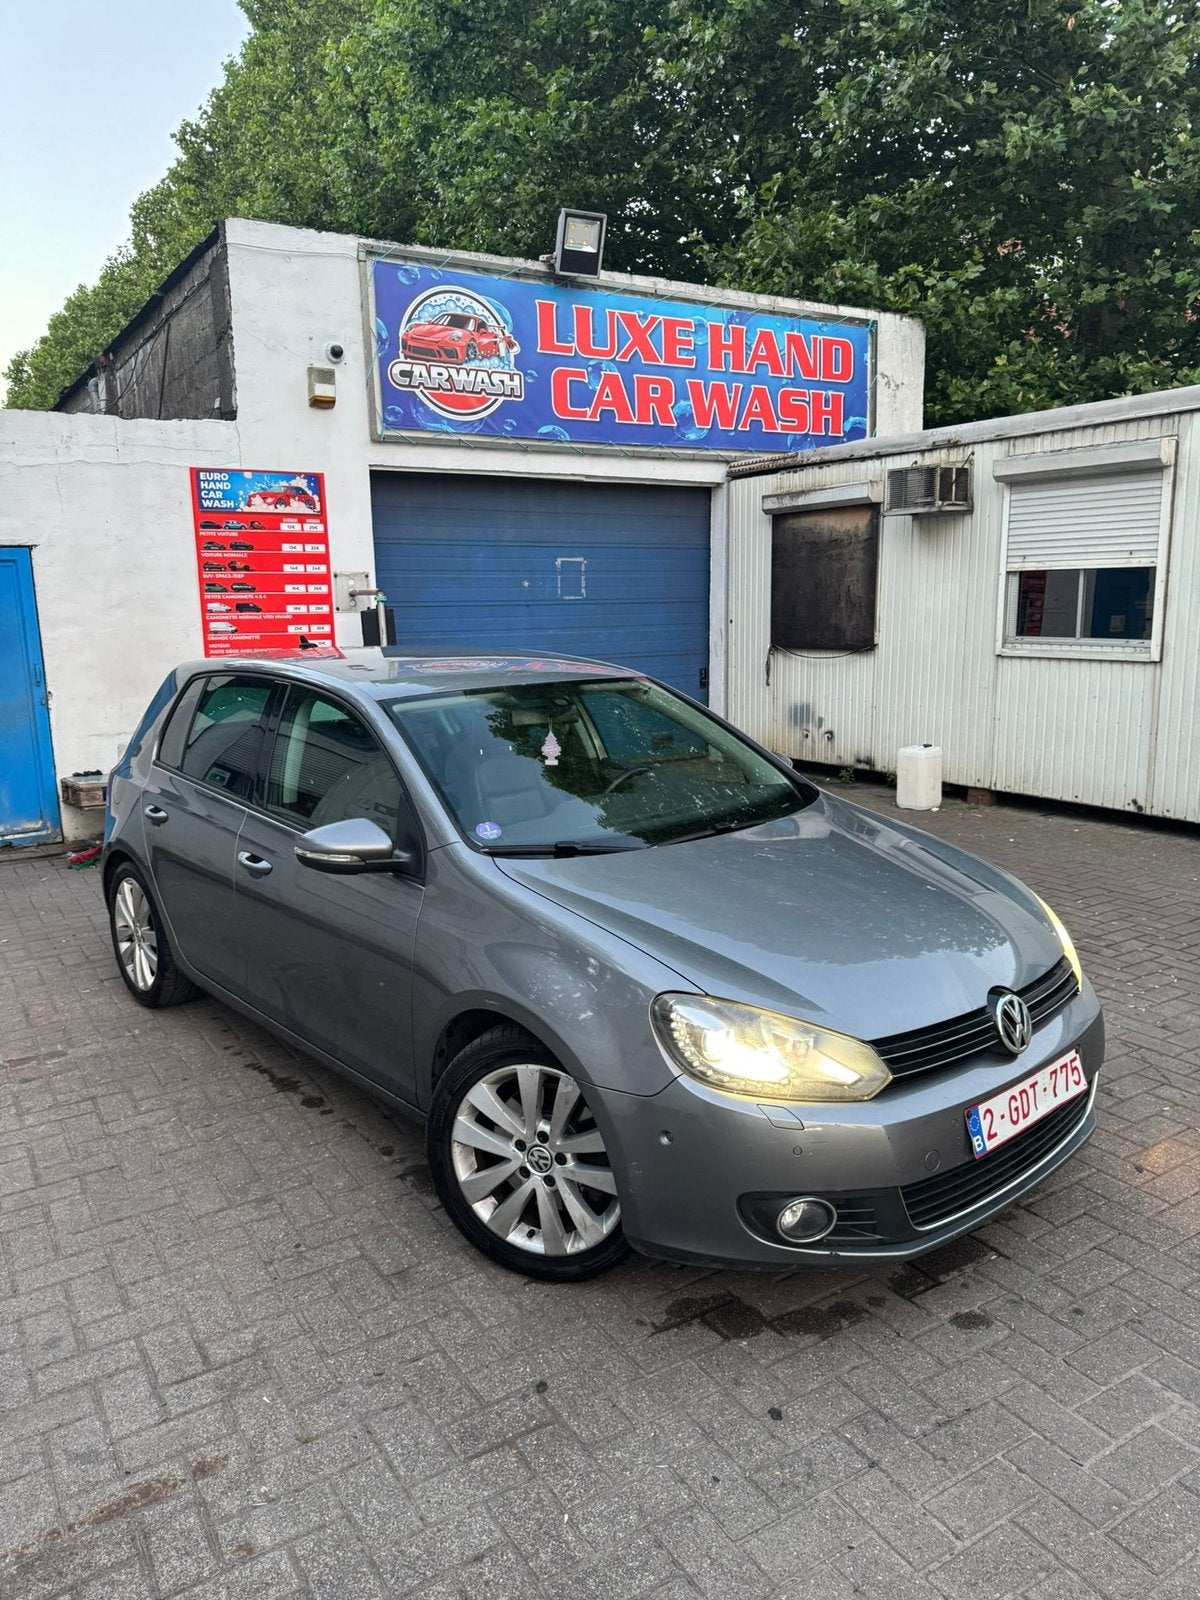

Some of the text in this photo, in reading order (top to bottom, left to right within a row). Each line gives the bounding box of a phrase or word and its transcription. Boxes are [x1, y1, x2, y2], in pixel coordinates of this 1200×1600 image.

[535, 299, 853, 383] LUXE HAND
[551, 367, 844, 436] CAR WASH
[200, 471, 229, 480] EURO
[200, 481, 231, 490] HAND
[201, 490, 223, 499] CAR
[202, 500, 235, 508] WASH
[983, 1056, 1082, 1142] 2-GDT-775
[974, 1135, 984, 1152] B
